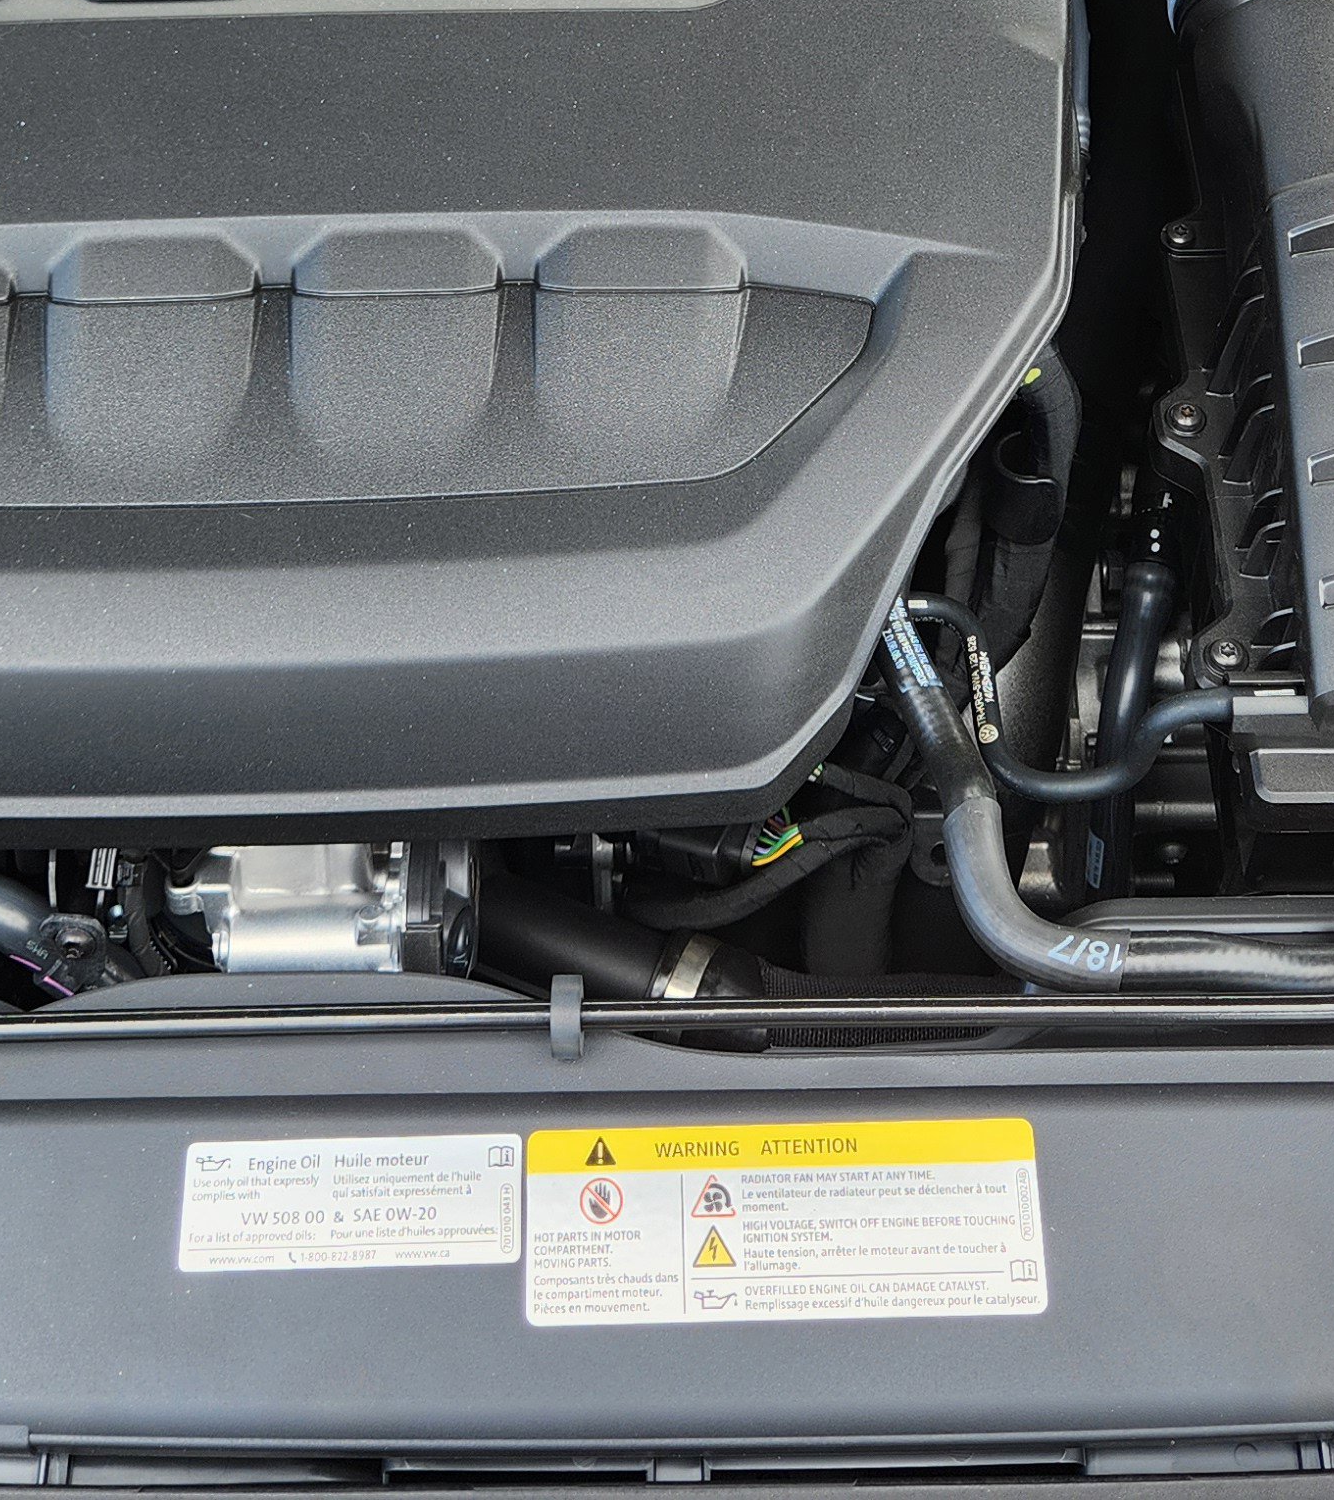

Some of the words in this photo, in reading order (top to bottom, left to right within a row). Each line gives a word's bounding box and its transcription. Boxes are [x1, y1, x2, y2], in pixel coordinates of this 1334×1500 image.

[1048, 934, 1122, 973] 18/7
[654, 1140, 740, 1158] WARNING
[760, 1137, 858, 1156] ATTENTION
[248, 1155, 297, 1175] Engine
[300, 1153, 321, 1169] Oil
[334, 1153, 372, 1168] Huile
[376, 1153, 430, 1167] moteur
[333, 1174, 370, 1185] Utilisez
[372, 1171, 435, 1186] uniquement
[436, 1171, 450, 1182] de
[451, 1170, 482, 1182] l'huile
[741, 1173, 791, 1184] RADIATOR
[793, 1173, 814, 1183] FAN
[816, 1172, 837, 1182] MAY
[839, 1171, 870, 1182] START
[871, 1171, 883, 1181] AT
[885, 1171, 906, 1181] ANY
[907, 1170, 935, 1180] TIME.
[332, 1187, 349, 1201] qui
[350, 1186, 391, 1198] satisfait
[392, 1185, 464, 1200] expressément
[465, 1183, 472, 1195] à
[741, 1189, 754, 1200] Le
[755, 1188, 812, 1199] ventilateur
[813, 1186, 827, 1198] de
[829, 1186, 877, 1197] radiateur
[878, 1186, 902, 1199] peut
[904, 1187, 916, 1196] se
[918, 1184, 974, 1195] déclencher
[975, 1183, 983, 1194] à
[984, 1184, 1007, 1194] tout
[741, 1202, 789, 1212] moment.
[241, 1211, 269, 1226] VW
[272, 1211, 300, 1225] 508
[304, 1210, 325, 1224] 00
[333, 1211, 344, 1224] &
[353, 1207, 381, 1223] SAE
[385, 1206, 437, 1222] 0W-20
[742, 1220, 768, 1231] HIGH
[769, 1219, 817, 1231] VOLTAGE,
[818, 1218, 858, 1230] SWITCH
[859, 1217, 880, 1229] OFF
[881, 1217, 920, 1228] ENGINE
[921, 1215, 962, 1228] BEFORE
[963, 1214, 1016, 1226] TOUCHING
[534, 1232, 555, 1243] HOT
[557, 1231, 588, 1242] PARTS
[590, 1231, 602, 1242] IN
[604, 1230, 641, 1241] MOTOR
[743, 1232, 789, 1244] IGNITION
[791, 1231, 833, 1242] SYSTEM.
[300, 1249, 377, 1262] 1-800-822-8987
[394, 1249, 451, 1259] www.vw.ca
[533, 1243, 613, 1256] COMPARTMENT.
[743, 1247, 775, 1259] Haute
[776, 1246, 819, 1259] tension,
[820, 1245, 857, 1258] arrêter
[858, 1245, 869, 1256] le
[870, 1246, 909, 1256] moteur
[910, 1245, 941, 1255] avant
[942, 1243, 956, 1255] de
[957, 1242, 999, 1254] toucher
[999, 1241, 1007, 1253] à
[209, 1255, 275, 1265] www.vw.com
[534, 1257, 576, 1269] MOVING
[577, 1256, 612, 1268] PARTS.
[743, 1260, 801, 1273] l'allumage.
[533, 1275, 595, 1288] Composants
[596, 1272, 616, 1285] très
[617, 1272, 653, 1284] chauds
[654, 1272, 679, 1283] dans
[533, 1289, 543, 1301] le
[545, 1288, 620, 1302] compartiment
[621, 1288, 663, 1298] moteur.
[744, 1284, 807, 1296] OVERFILLED
[808, 1283, 848, 1295] ENGINE
[850, 1283, 868, 1294] OIL
[868, 1282, 890, 1294] CAN
[892, 1281, 936, 1293] DAMAGE
[938, 1280, 989, 1292] CATALYST.
[533, 1303, 567, 1315] Pièces
[568, 1304, 582, 1314] en
[584, 1302, 650, 1313] mouvement.
[745, 1298, 810, 1313] Remplissage
[811, 1296, 852, 1309] excessif
[854, 1296, 889, 1308] d'huile
[891, 1296, 945, 1310] dangereux
[947, 1296, 972, 1309] pour
[973, 1293, 983, 1305] le
[985, 1293, 1041, 1308] catalyseur.
